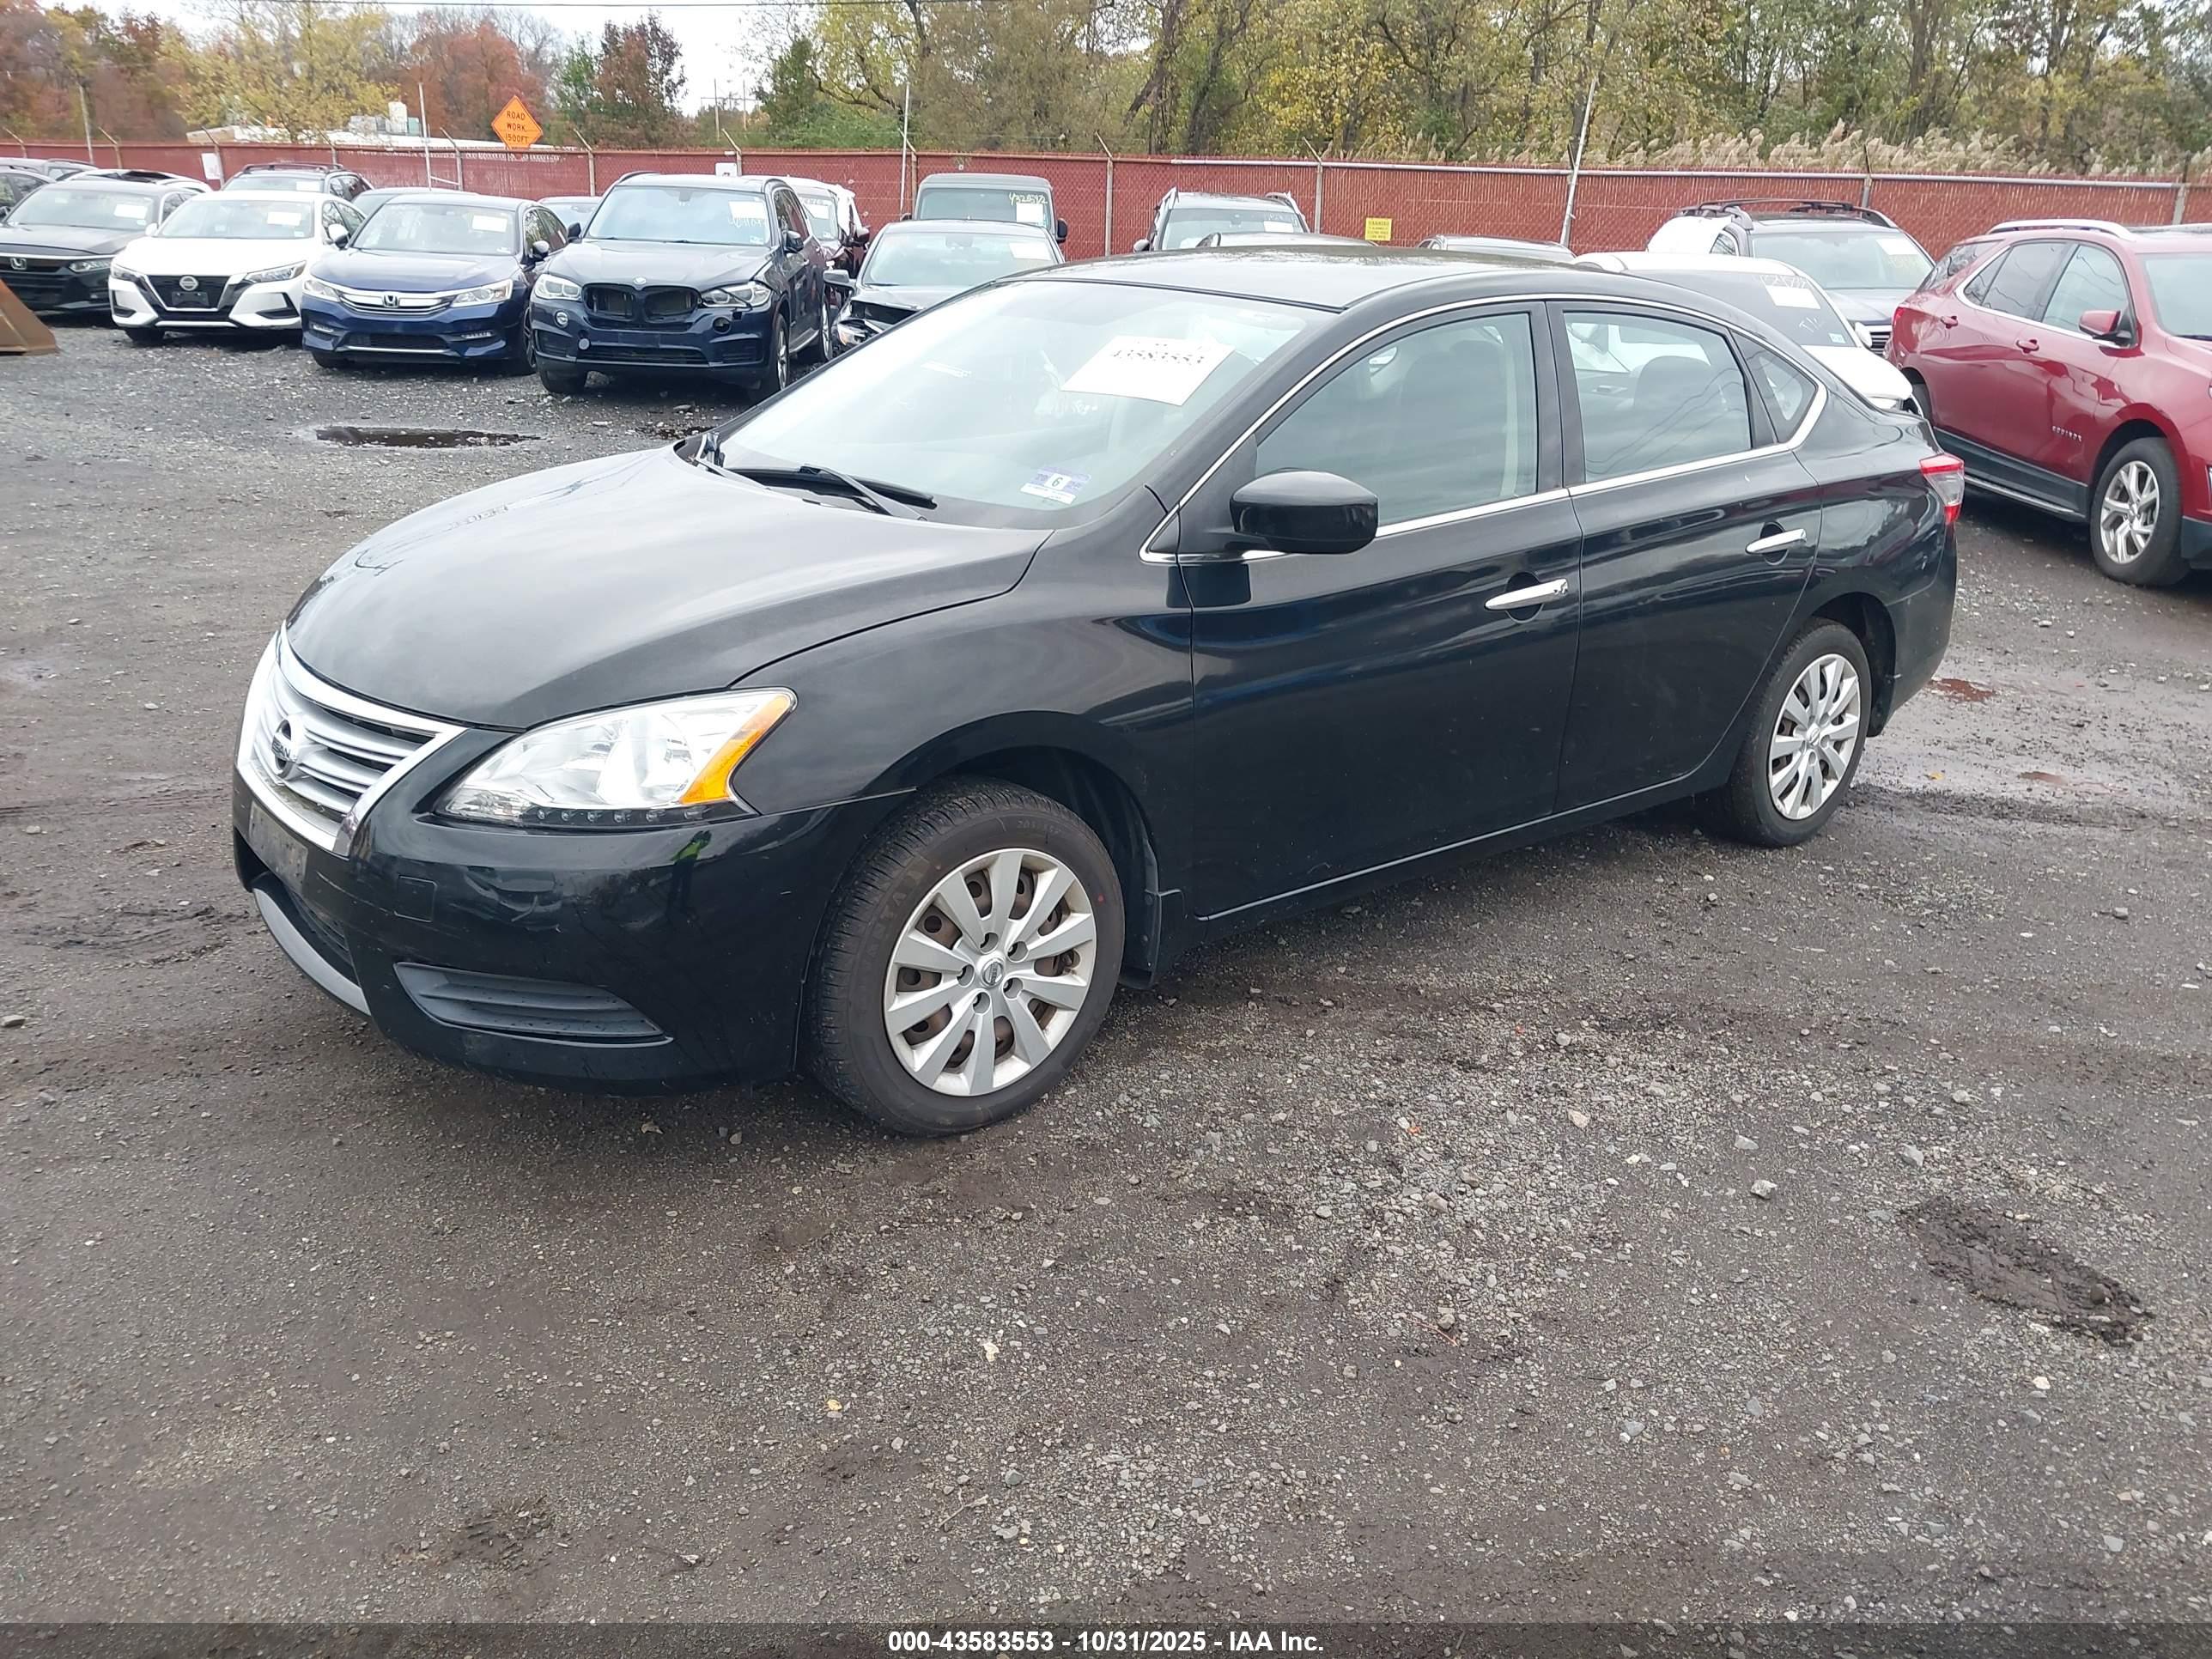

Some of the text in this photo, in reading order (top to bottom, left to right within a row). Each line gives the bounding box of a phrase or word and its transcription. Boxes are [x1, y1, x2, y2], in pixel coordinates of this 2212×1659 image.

[507, 110, 526, 120] ROAD
[507, 123, 526, 131] WORK
[1051, 477, 1064, 488] 6
